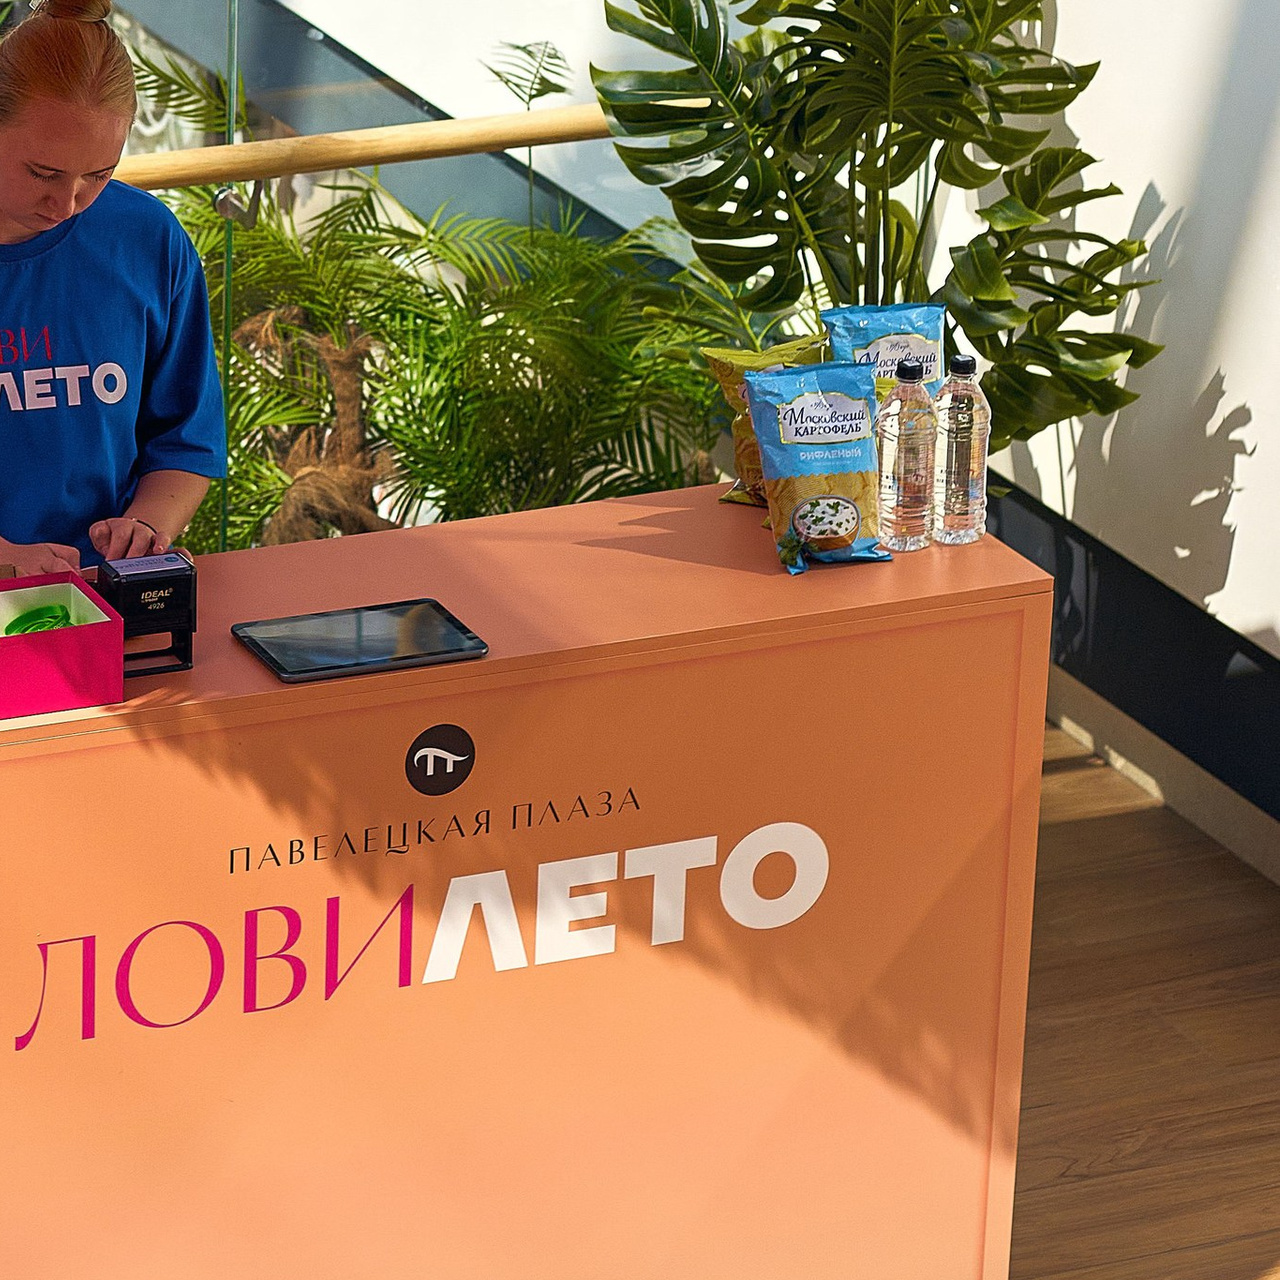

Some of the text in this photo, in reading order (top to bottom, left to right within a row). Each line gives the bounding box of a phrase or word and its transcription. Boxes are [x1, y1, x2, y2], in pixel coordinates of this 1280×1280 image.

[782, 407, 866, 426] Московский
[147, 602, 165, 610] 4926
[229, 787, 641, 874] ПАВЕЛЕЦКАЯ ПЛАЗА
